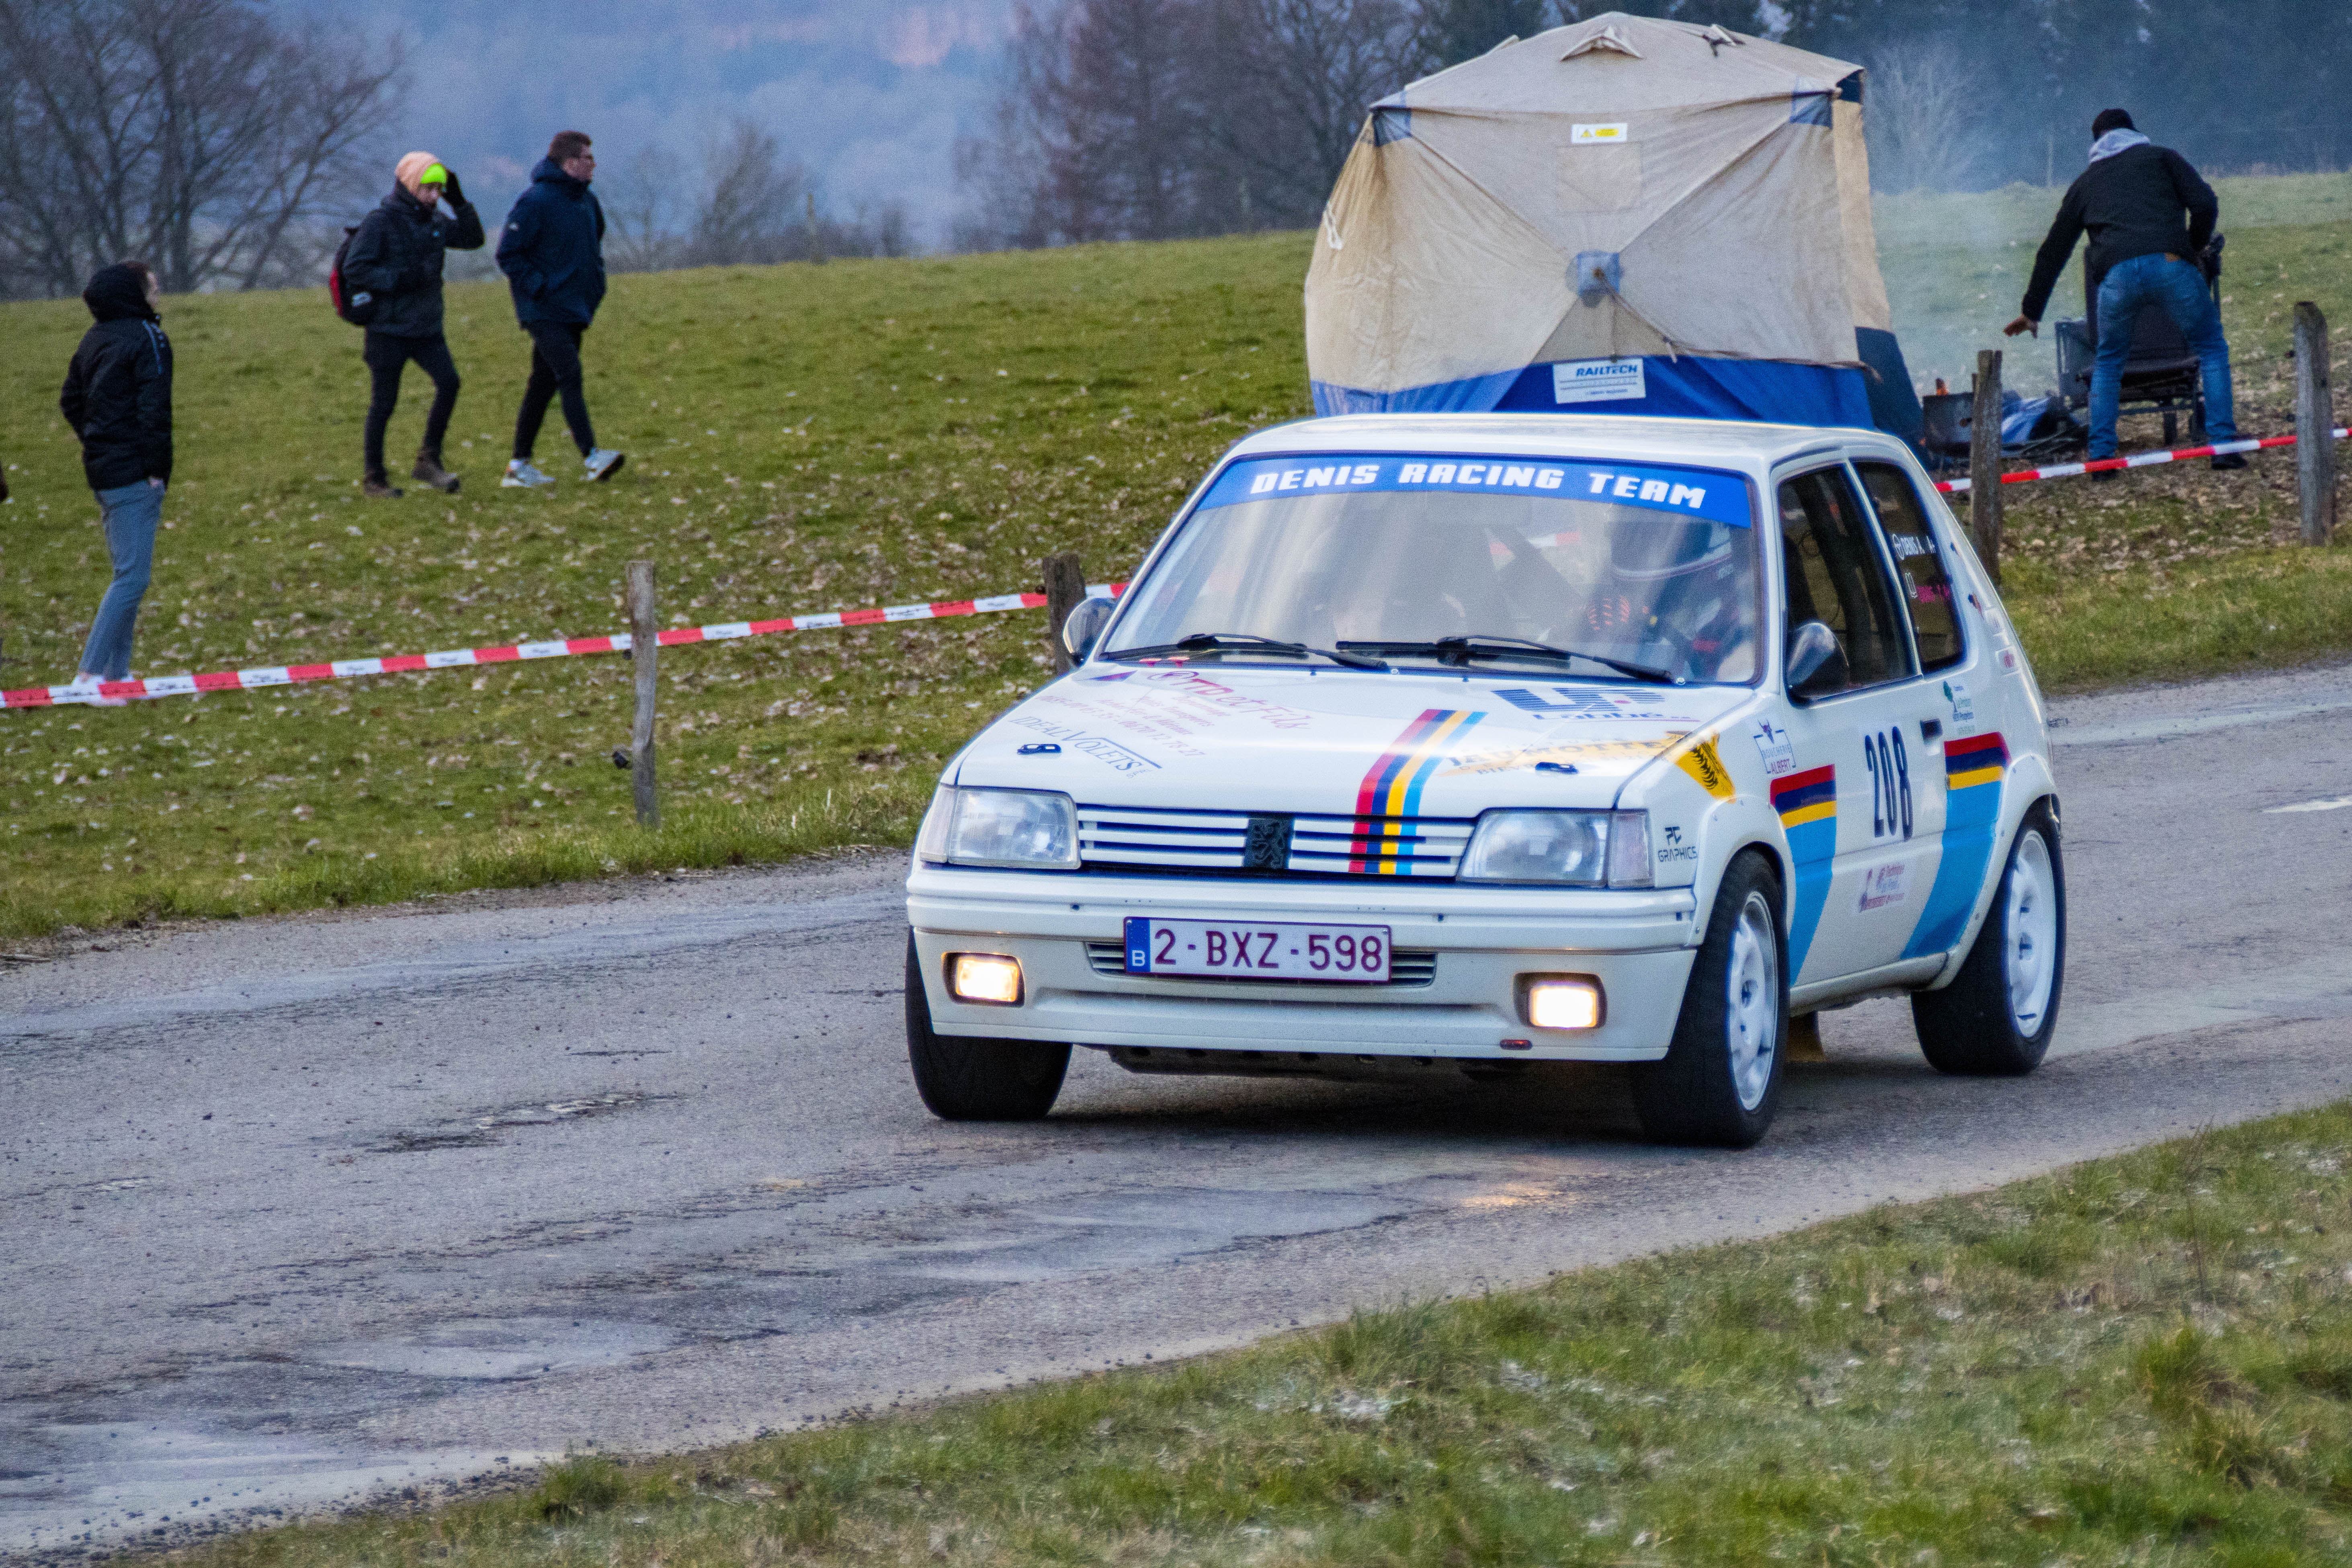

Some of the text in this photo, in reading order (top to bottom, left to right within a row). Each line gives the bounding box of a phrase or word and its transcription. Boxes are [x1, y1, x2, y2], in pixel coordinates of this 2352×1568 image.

[1576, 365, 1637, 377] RAILTECH
[1250, 463, 1706, 509] DENIS RACING TEAM
[1061, 730, 1144, 771] VOLETS
[1770, 758, 1791, 775] ALBERT
[1865, 726, 1914, 842] 208
[1657, 846, 1698, 863] GRAPHICS
[1131, 949, 1145, 967] B
[1154, 928, 1383, 973] 2-BXZ-598
